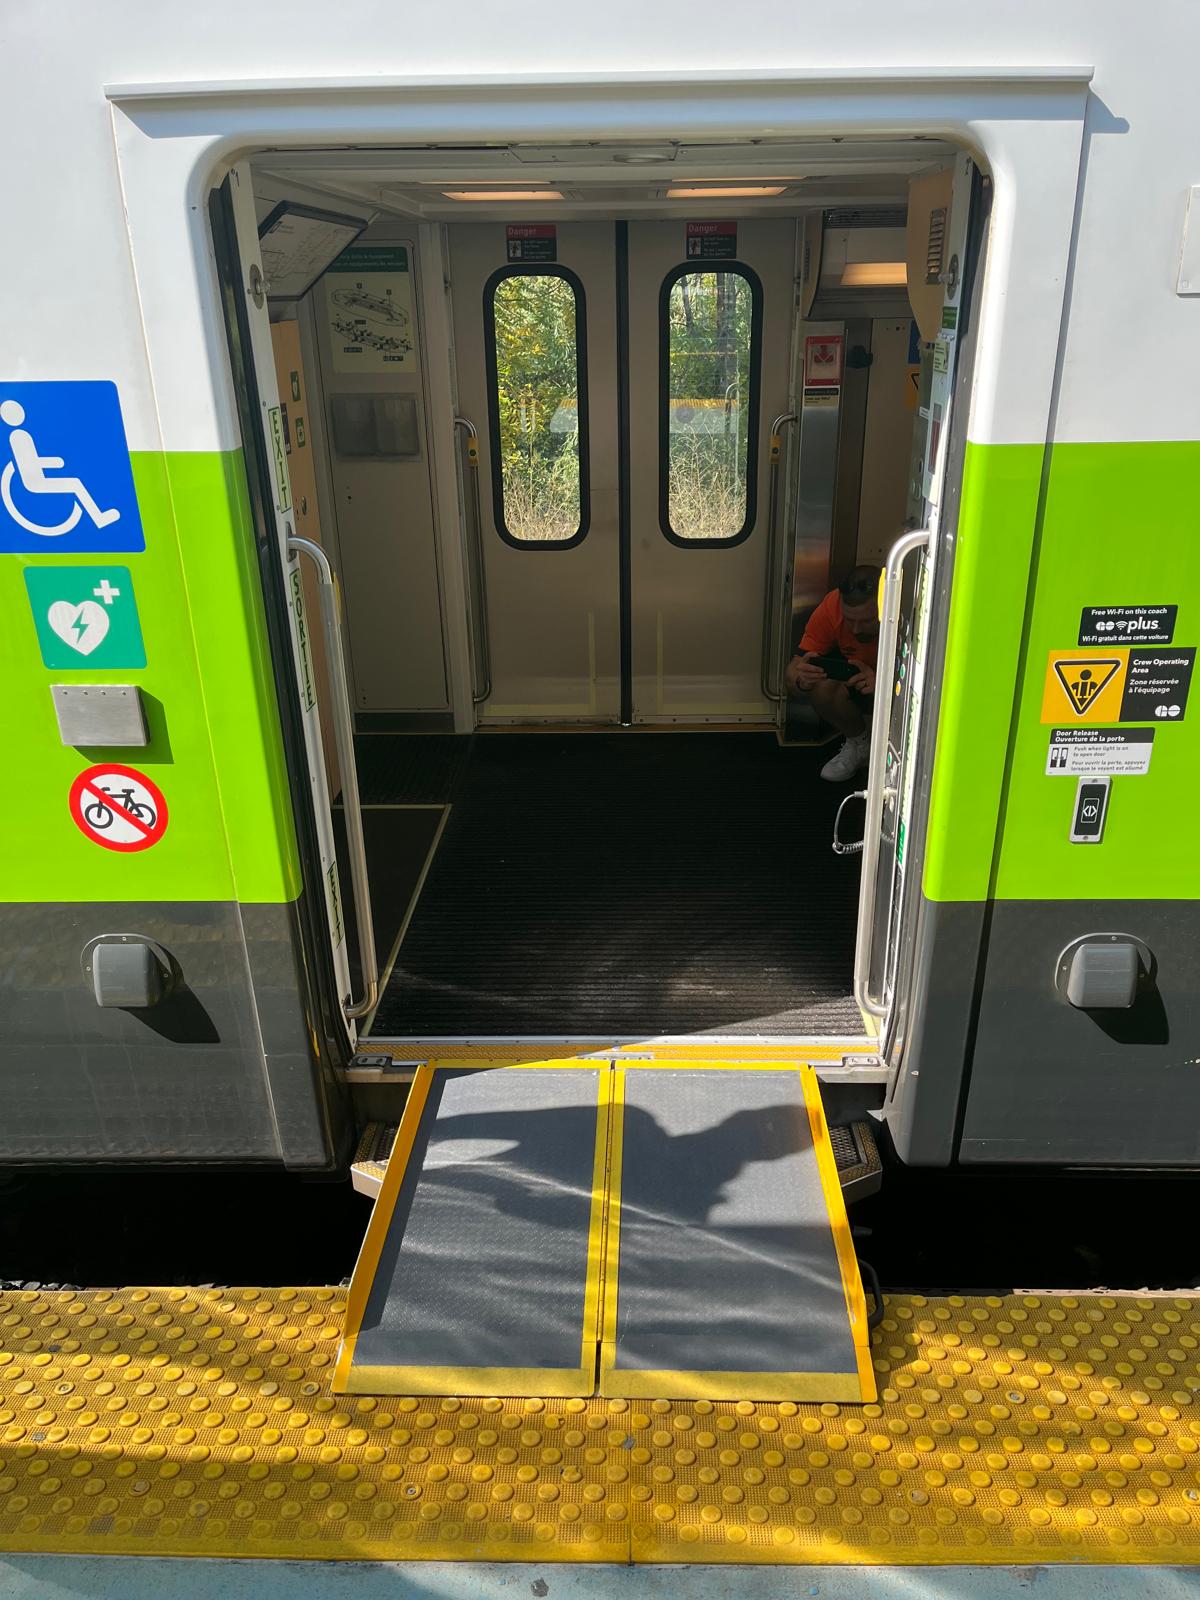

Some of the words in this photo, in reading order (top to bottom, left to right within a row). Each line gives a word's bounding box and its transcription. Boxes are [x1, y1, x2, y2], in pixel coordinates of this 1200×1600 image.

[507, 226, 537, 237] Danger
[688, 223, 718, 234] Danger
[272, 411, 288, 508] EXIT
[1127, 616, 1159, 634] plus
[293, 574, 312, 706] SORTIE
[1098, 635, 1117, 643] gratuit
[1153, 658, 1189, 666] Operating
[1134, 686, 1170, 694] l'équipage
[329, 868, 342, 940] EXIT
